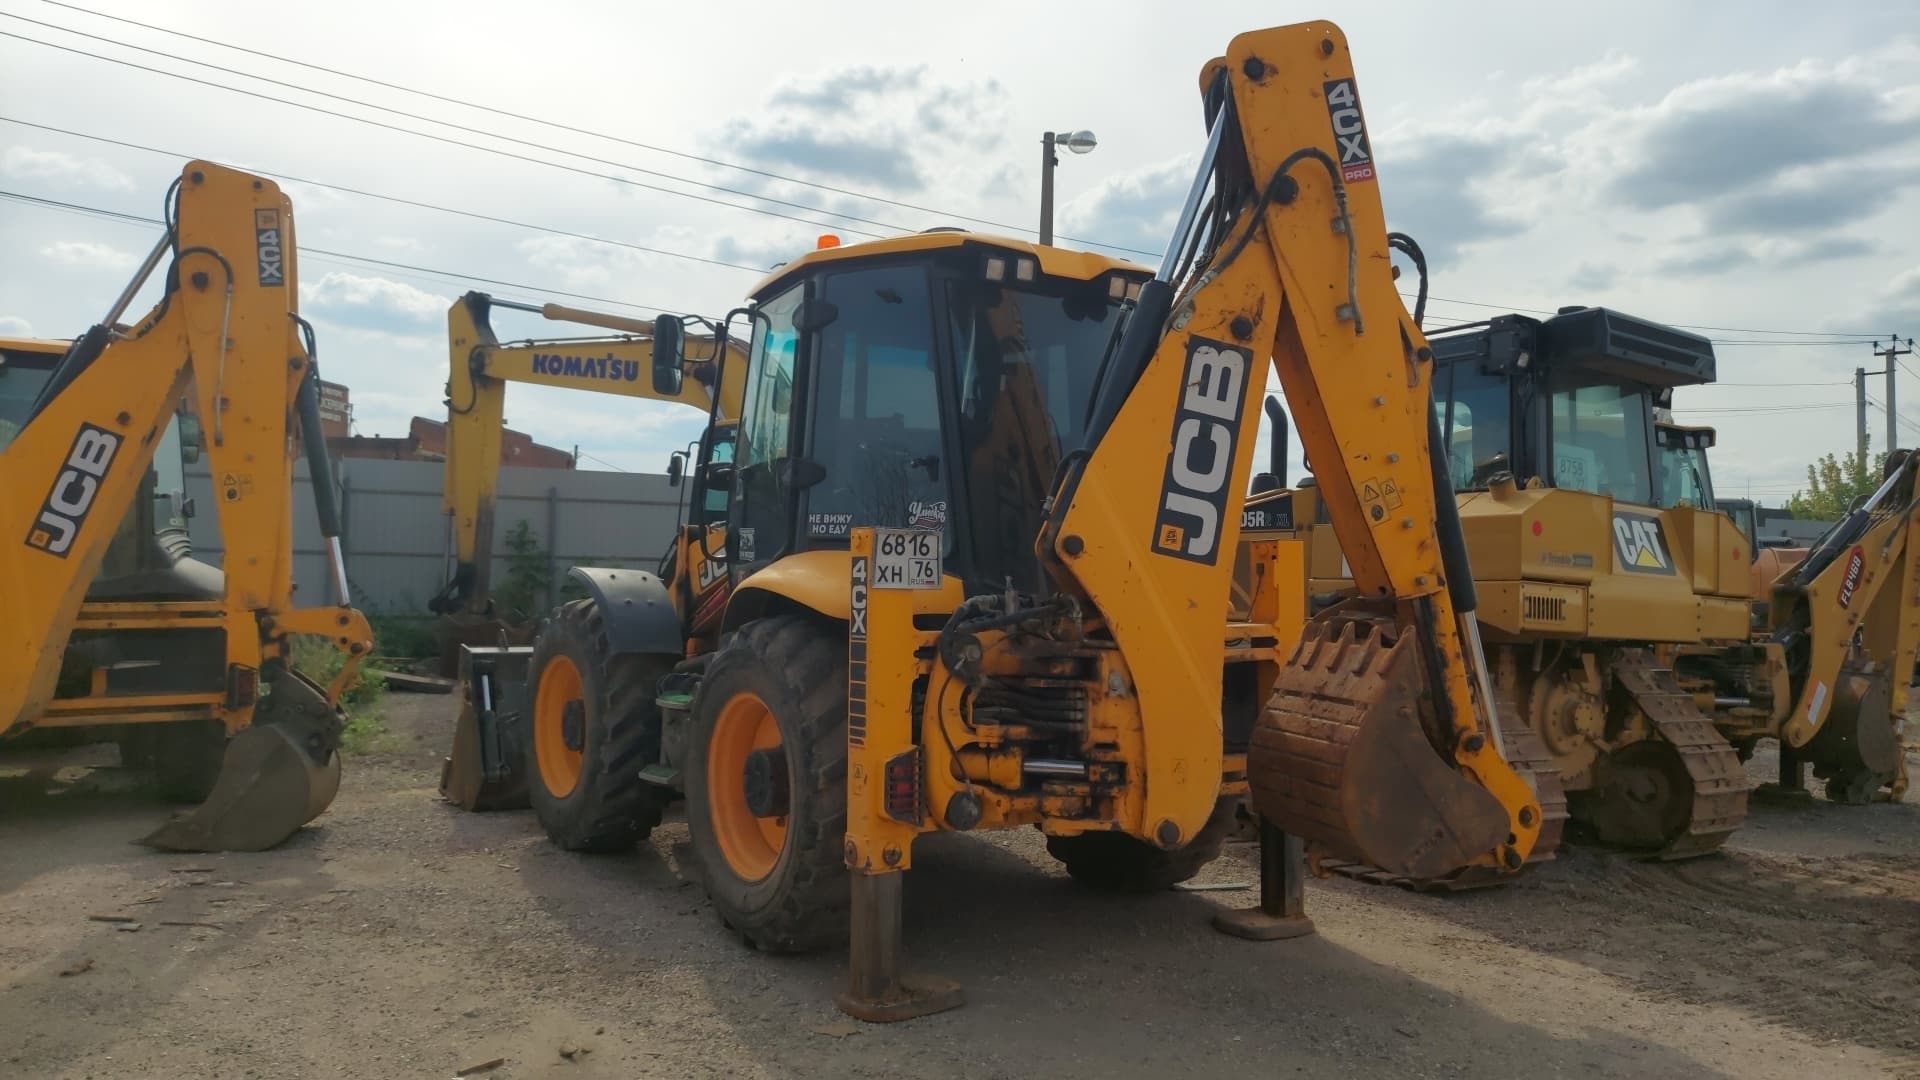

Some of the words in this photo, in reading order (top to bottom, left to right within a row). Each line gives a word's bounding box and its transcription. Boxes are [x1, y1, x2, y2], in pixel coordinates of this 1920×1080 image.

[1328, 82, 1369, 162] 4CX
[1344, 168, 1373, 182] PRO
[258, 230, 282, 278] 4CX
[532, 352, 640, 382] KOMATSU
[1165, 345, 1245, 556] JCB
[40, 429, 118, 553] JCB
[809, 514, 821, 524] НЕ
[823, 514, 852, 524] ВИЖУ
[812, 524, 827, 534] НО
[829, 524, 848, 535] ЕДУ
[881, 534, 930, 556] 6816
[1612, 517, 1668, 569] CAT
[914, 561, 933, 578] 76
[852, 559, 867, 634] 4CX
